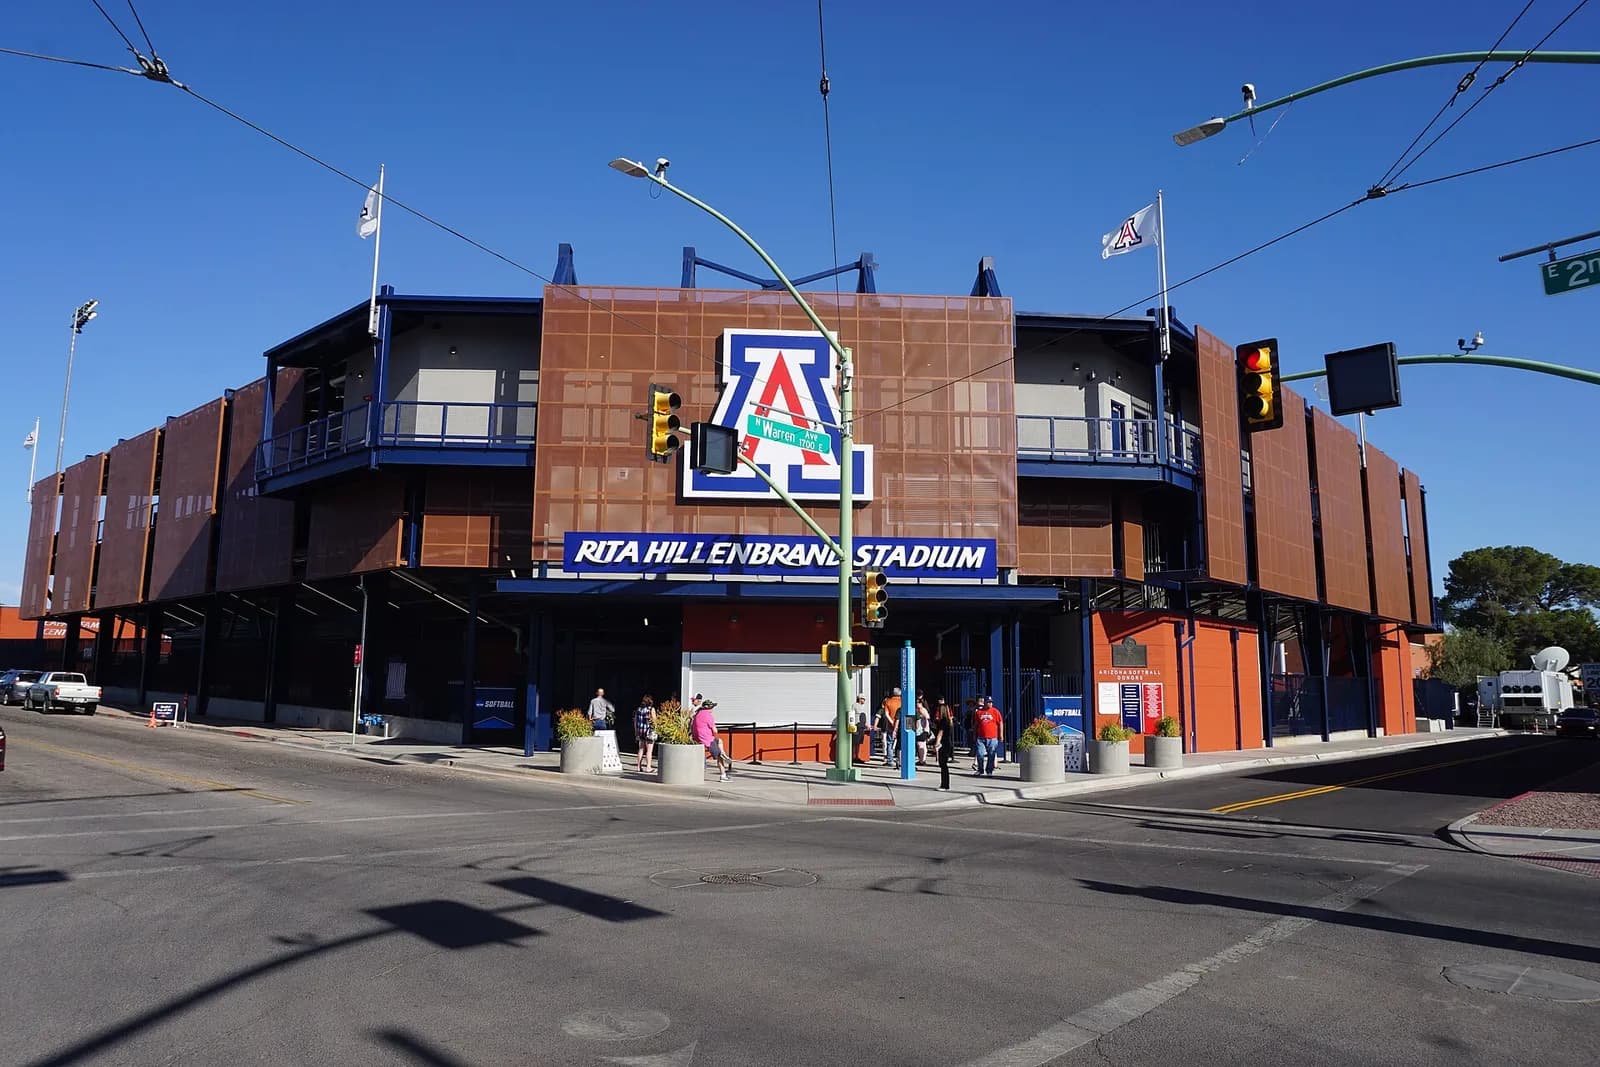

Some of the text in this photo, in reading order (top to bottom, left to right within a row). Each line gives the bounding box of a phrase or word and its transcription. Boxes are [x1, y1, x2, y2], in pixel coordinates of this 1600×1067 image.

[1547, 264, 1560, 278] E
[683, 328, 873, 500] A
[756, 417, 818, 442] N Warren Ave
[799, 438, 824, 452] 1700 E
[574, 540, 638, 564] RITA
[853, 545, 986, 568] STADIUM
[1053, 709, 1082, 717] SOFTBALL
